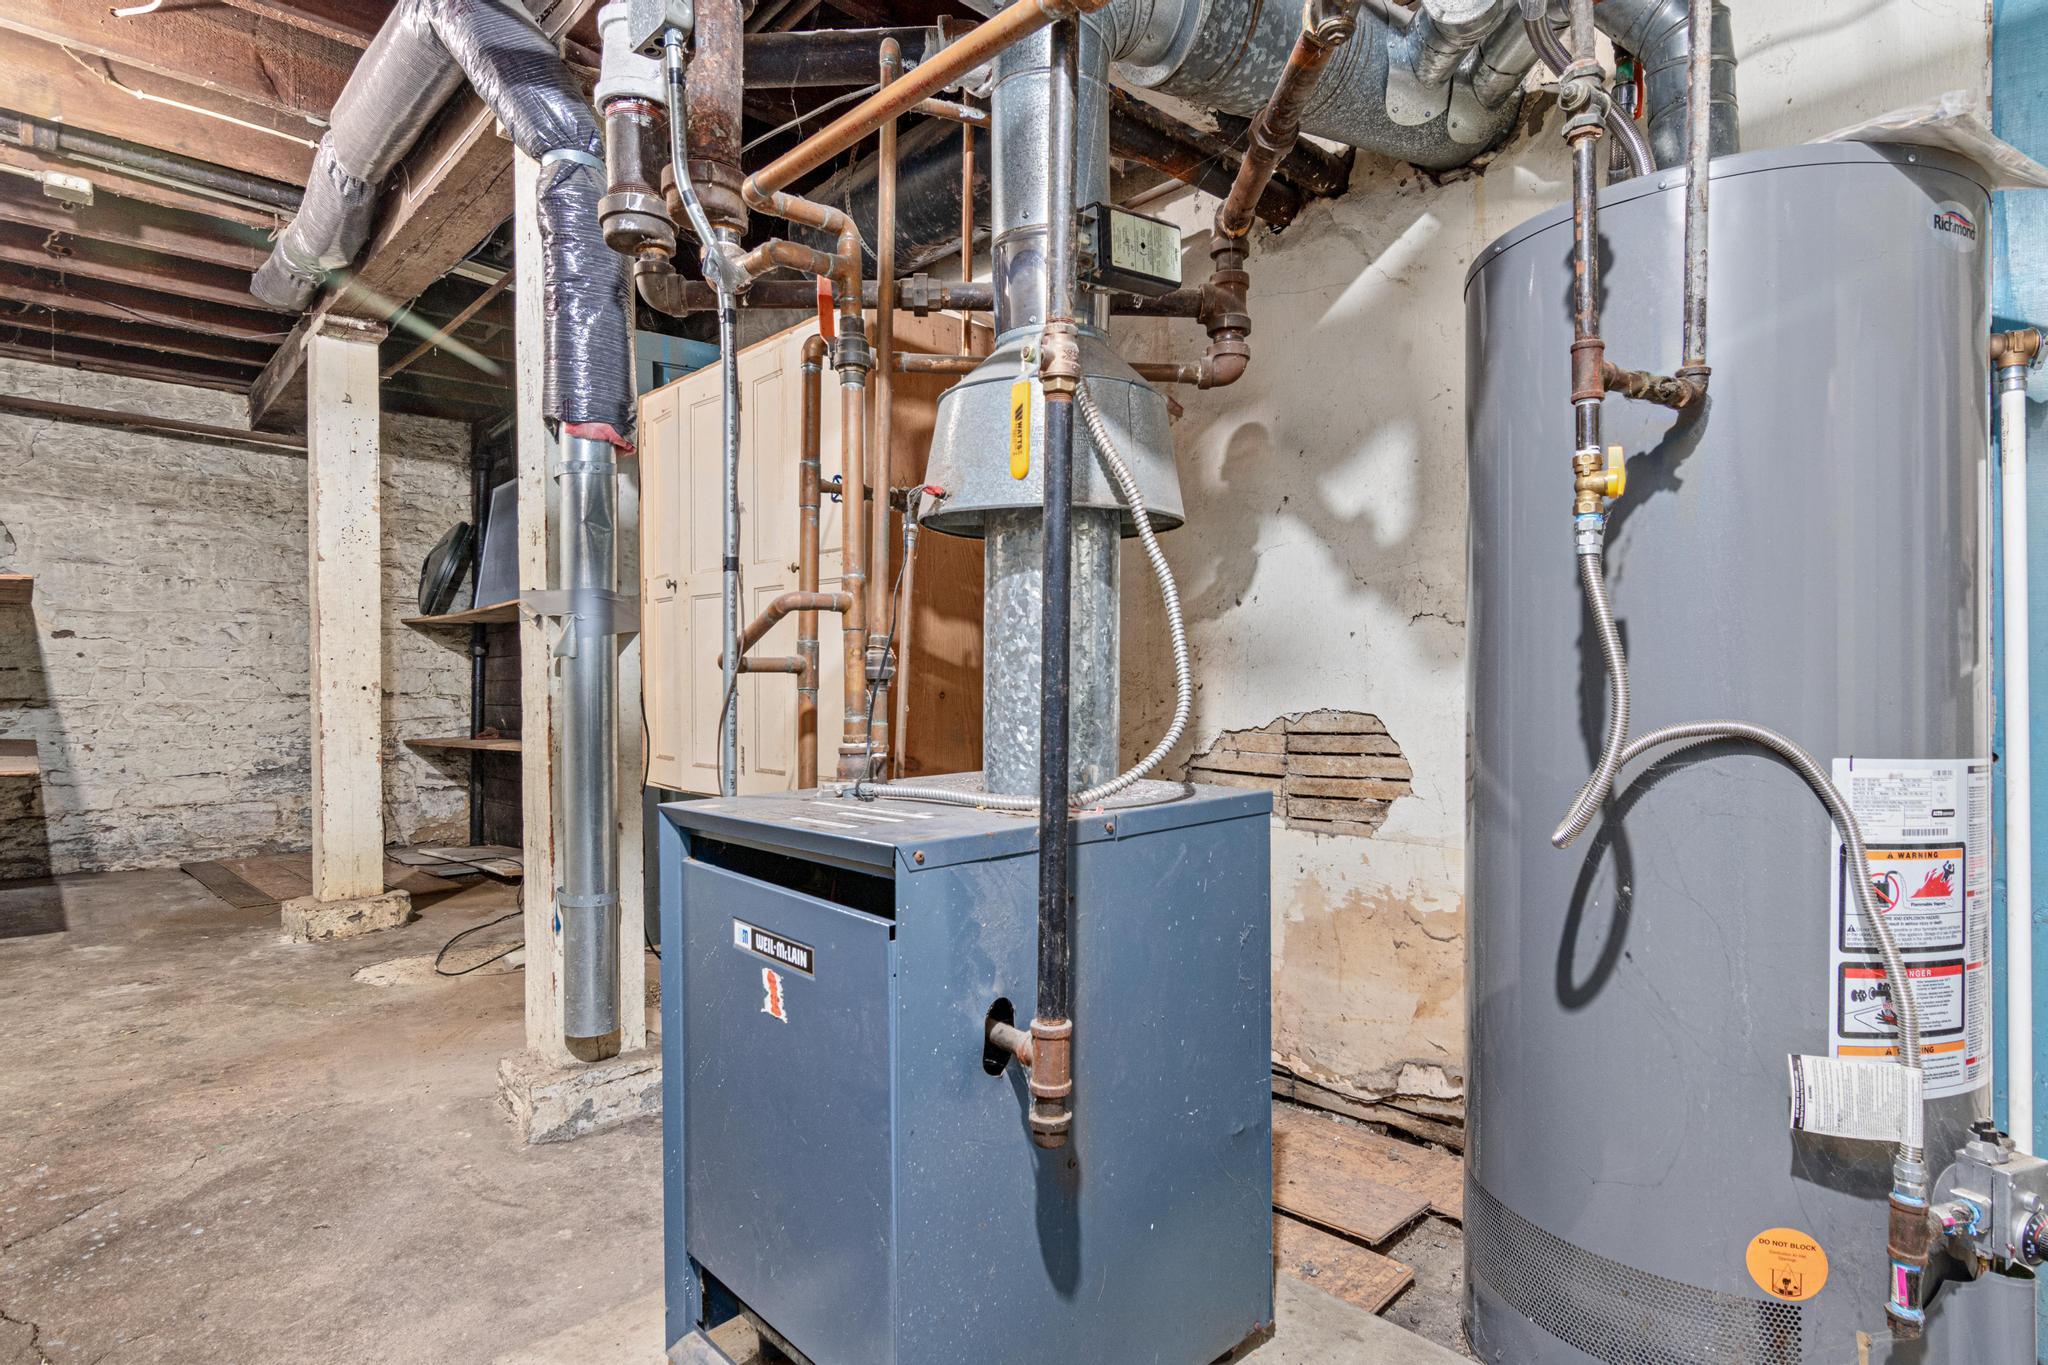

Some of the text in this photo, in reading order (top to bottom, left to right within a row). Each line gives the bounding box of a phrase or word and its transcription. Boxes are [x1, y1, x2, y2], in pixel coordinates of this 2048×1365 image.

[1934, 214, 1976, 240] Richmond
[1909, 969, 1932, 978] NGER
[1772, 1240, 1788, 1248] NOT
[1790, 1243, 1817, 1251] BLOCK
